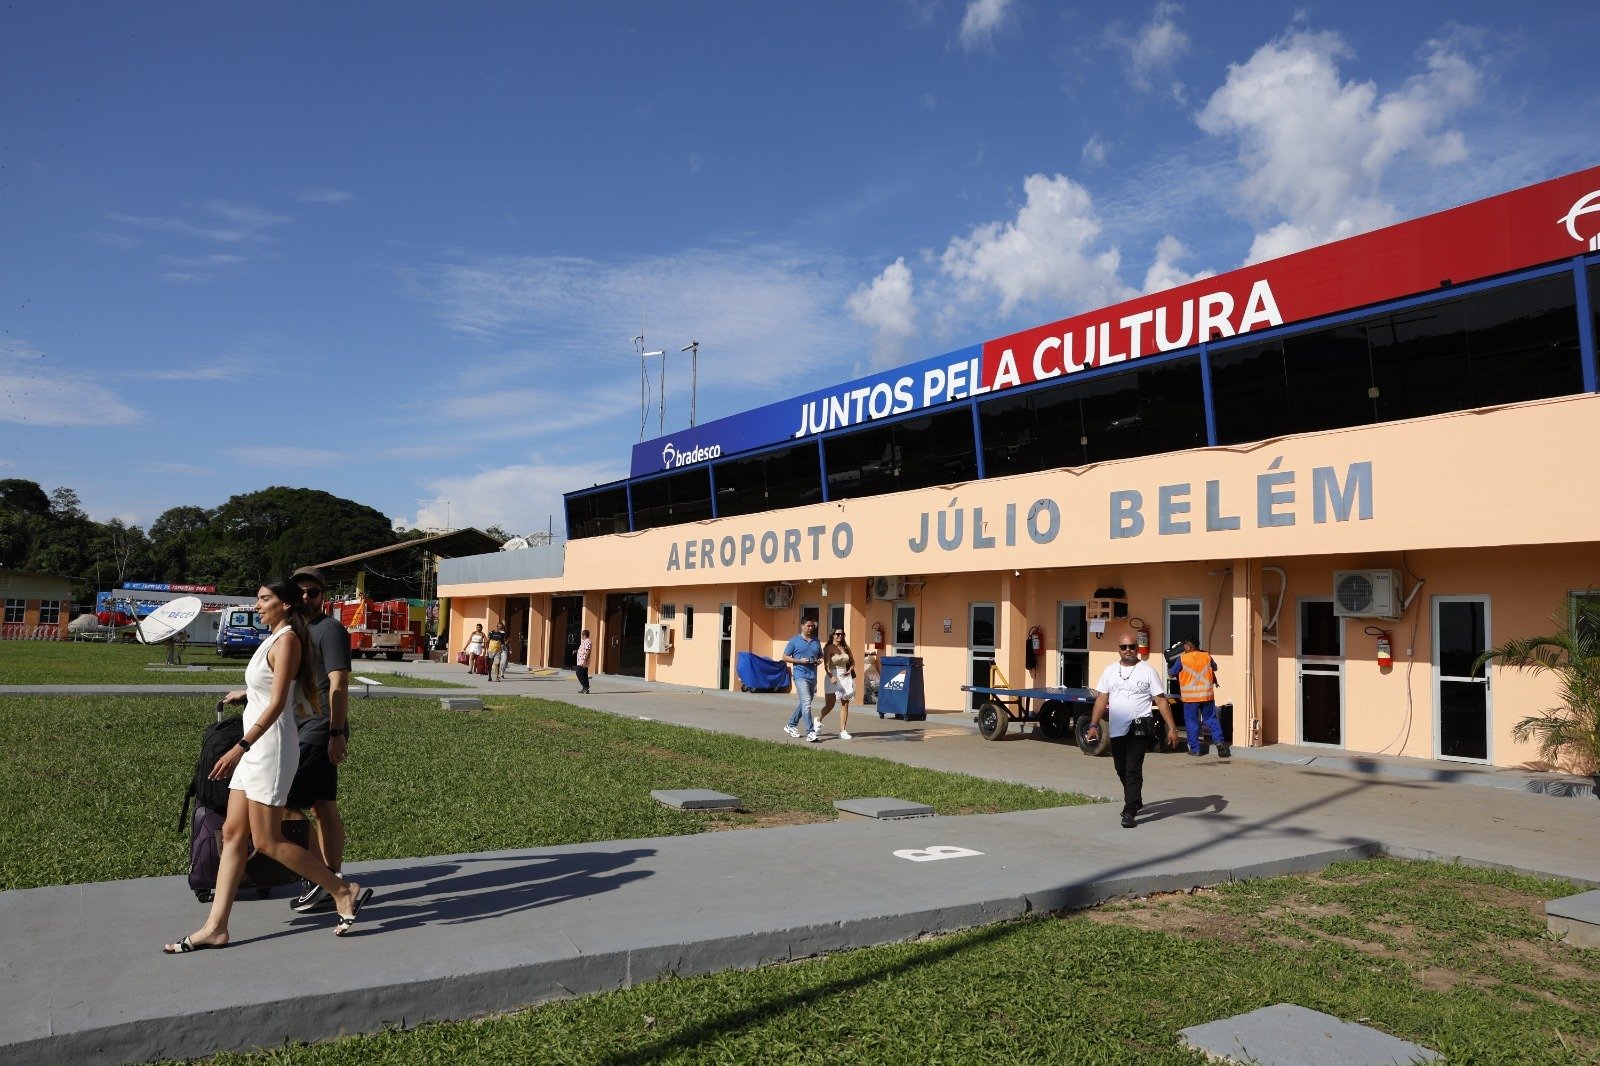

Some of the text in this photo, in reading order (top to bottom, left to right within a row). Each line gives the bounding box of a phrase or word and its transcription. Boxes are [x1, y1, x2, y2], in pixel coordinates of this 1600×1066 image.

[796, 279, 1284, 438] JUNTOS PELA CULTURA
[676, 443, 721, 467] bradesco
[666, 456, 1373, 571] AEROPORTO JÚLIO BELÉM
